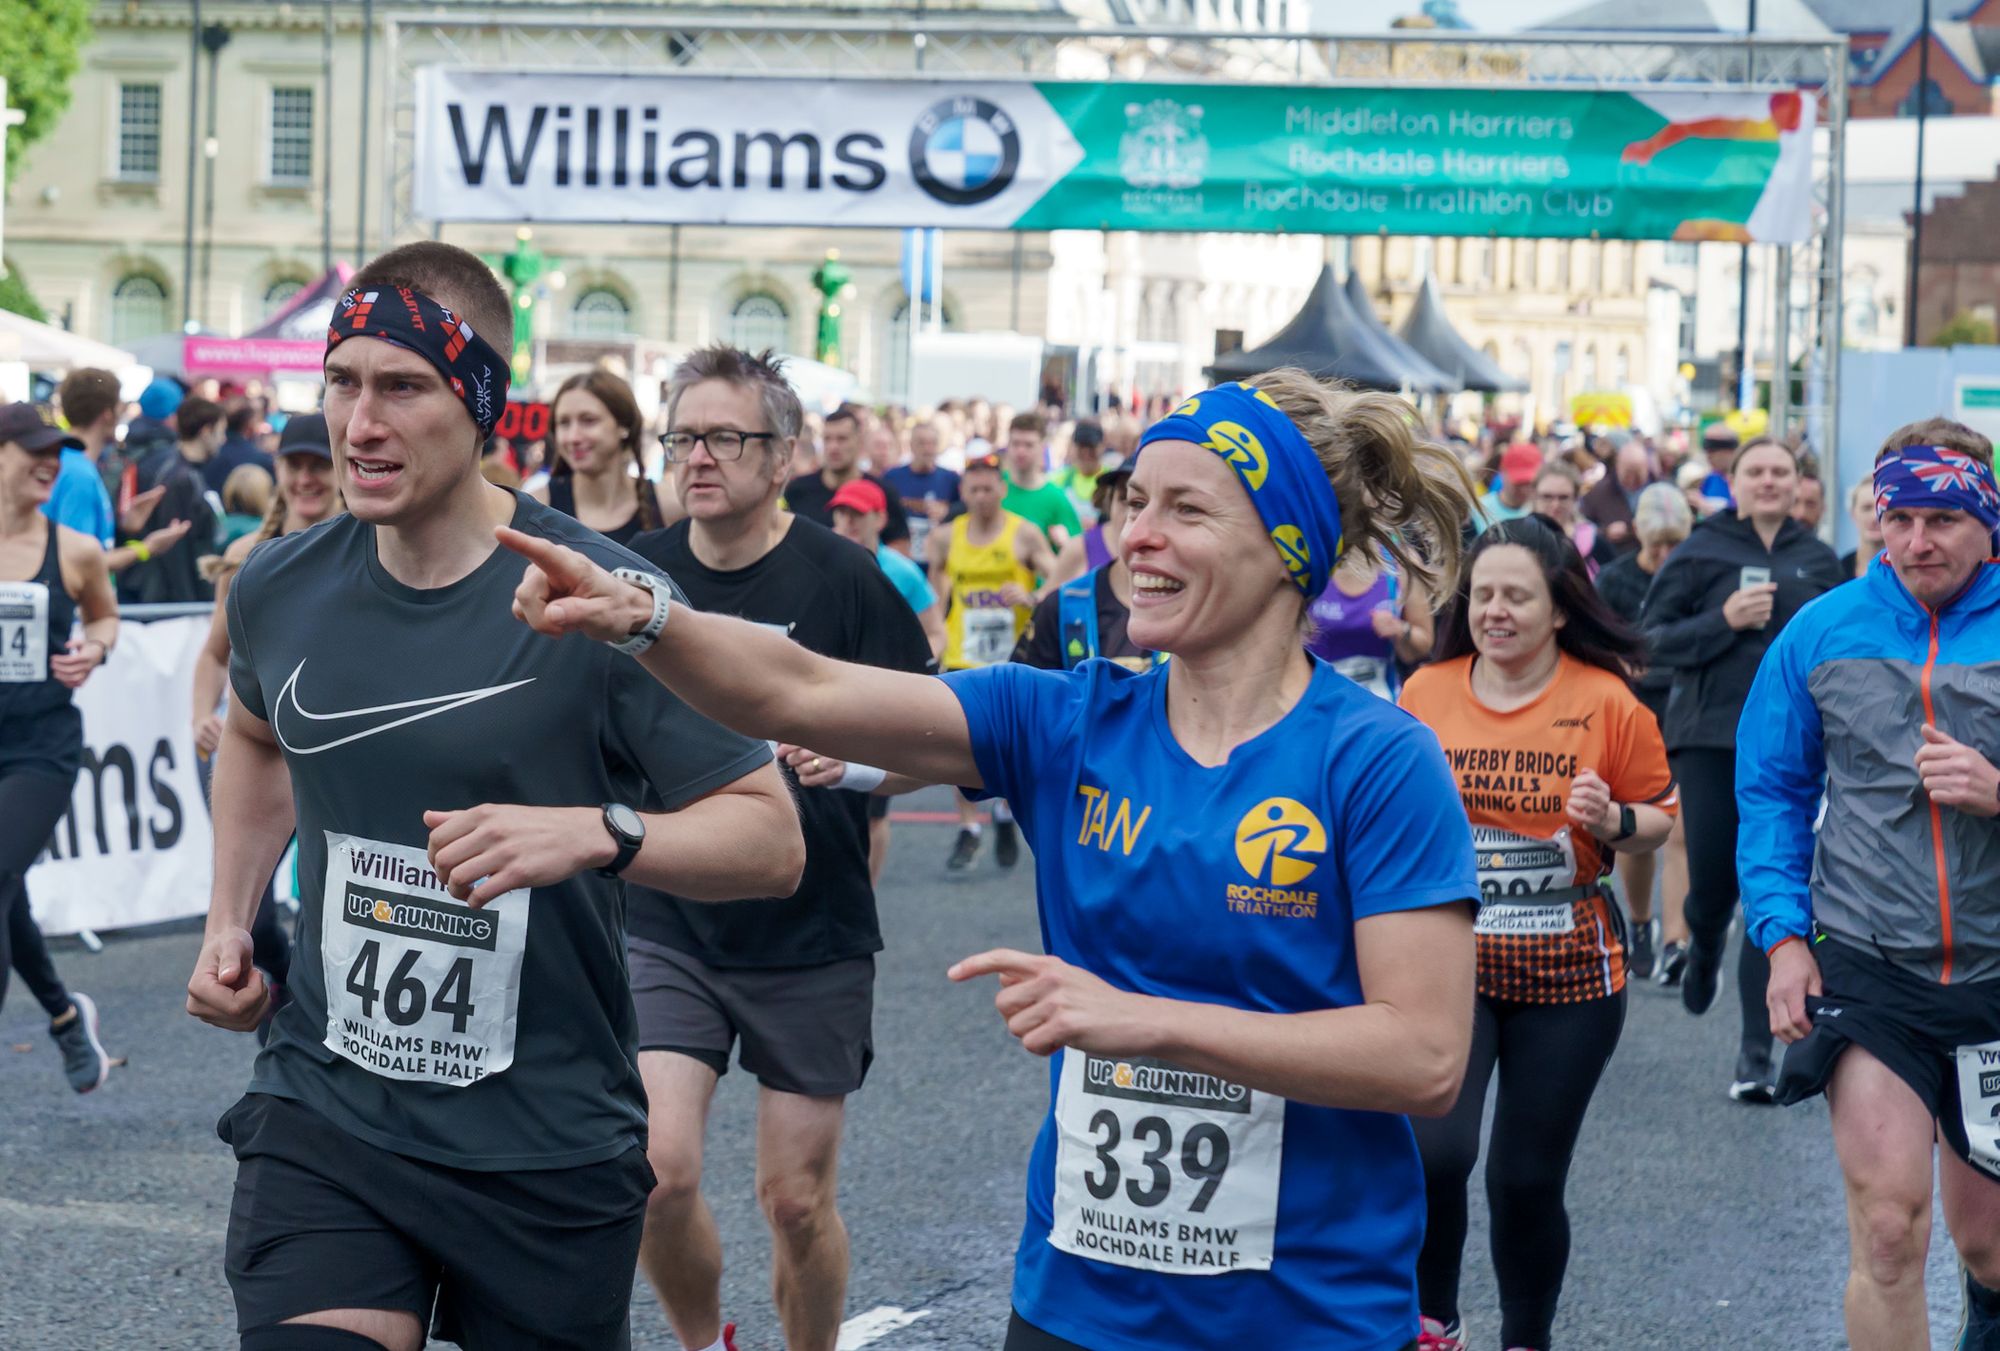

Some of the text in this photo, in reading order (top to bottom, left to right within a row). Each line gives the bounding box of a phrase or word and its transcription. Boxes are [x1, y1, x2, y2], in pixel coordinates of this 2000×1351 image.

[1285, 105, 1574, 140] Middleton Harriers
[446, 103, 888, 192] Williams
[1287, 142, 1570, 180] Rochdale Harriers
[1243, 181, 1614, 217] Rochdale Triathlon Club
[1444, 748, 1578, 779] OWERBY BRIDGE
[1461, 773, 1542, 793] SNAILS
[1077, 783, 1153, 857] TAN
[1462, 791, 1562, 814] NNING CLUB
[350, 848, 453, 893] William
[1225, 898, 1317, 919] TRIATHLON
[1226, 884, 1320, 906] ROCHDALE
[345, 938, 476, 1035] 464
[342, 1035, 485, 1081] ROCHDALE HALF
[343, 1018, 485, 1062] WILLIAMS BMW
[1083, 1108, 1232, 1214] 339
[1080, 1206, 1239, 1246] WILLIAMS BMW
[1075, 1229, 1242, 1268] ROCHDALE HALF
